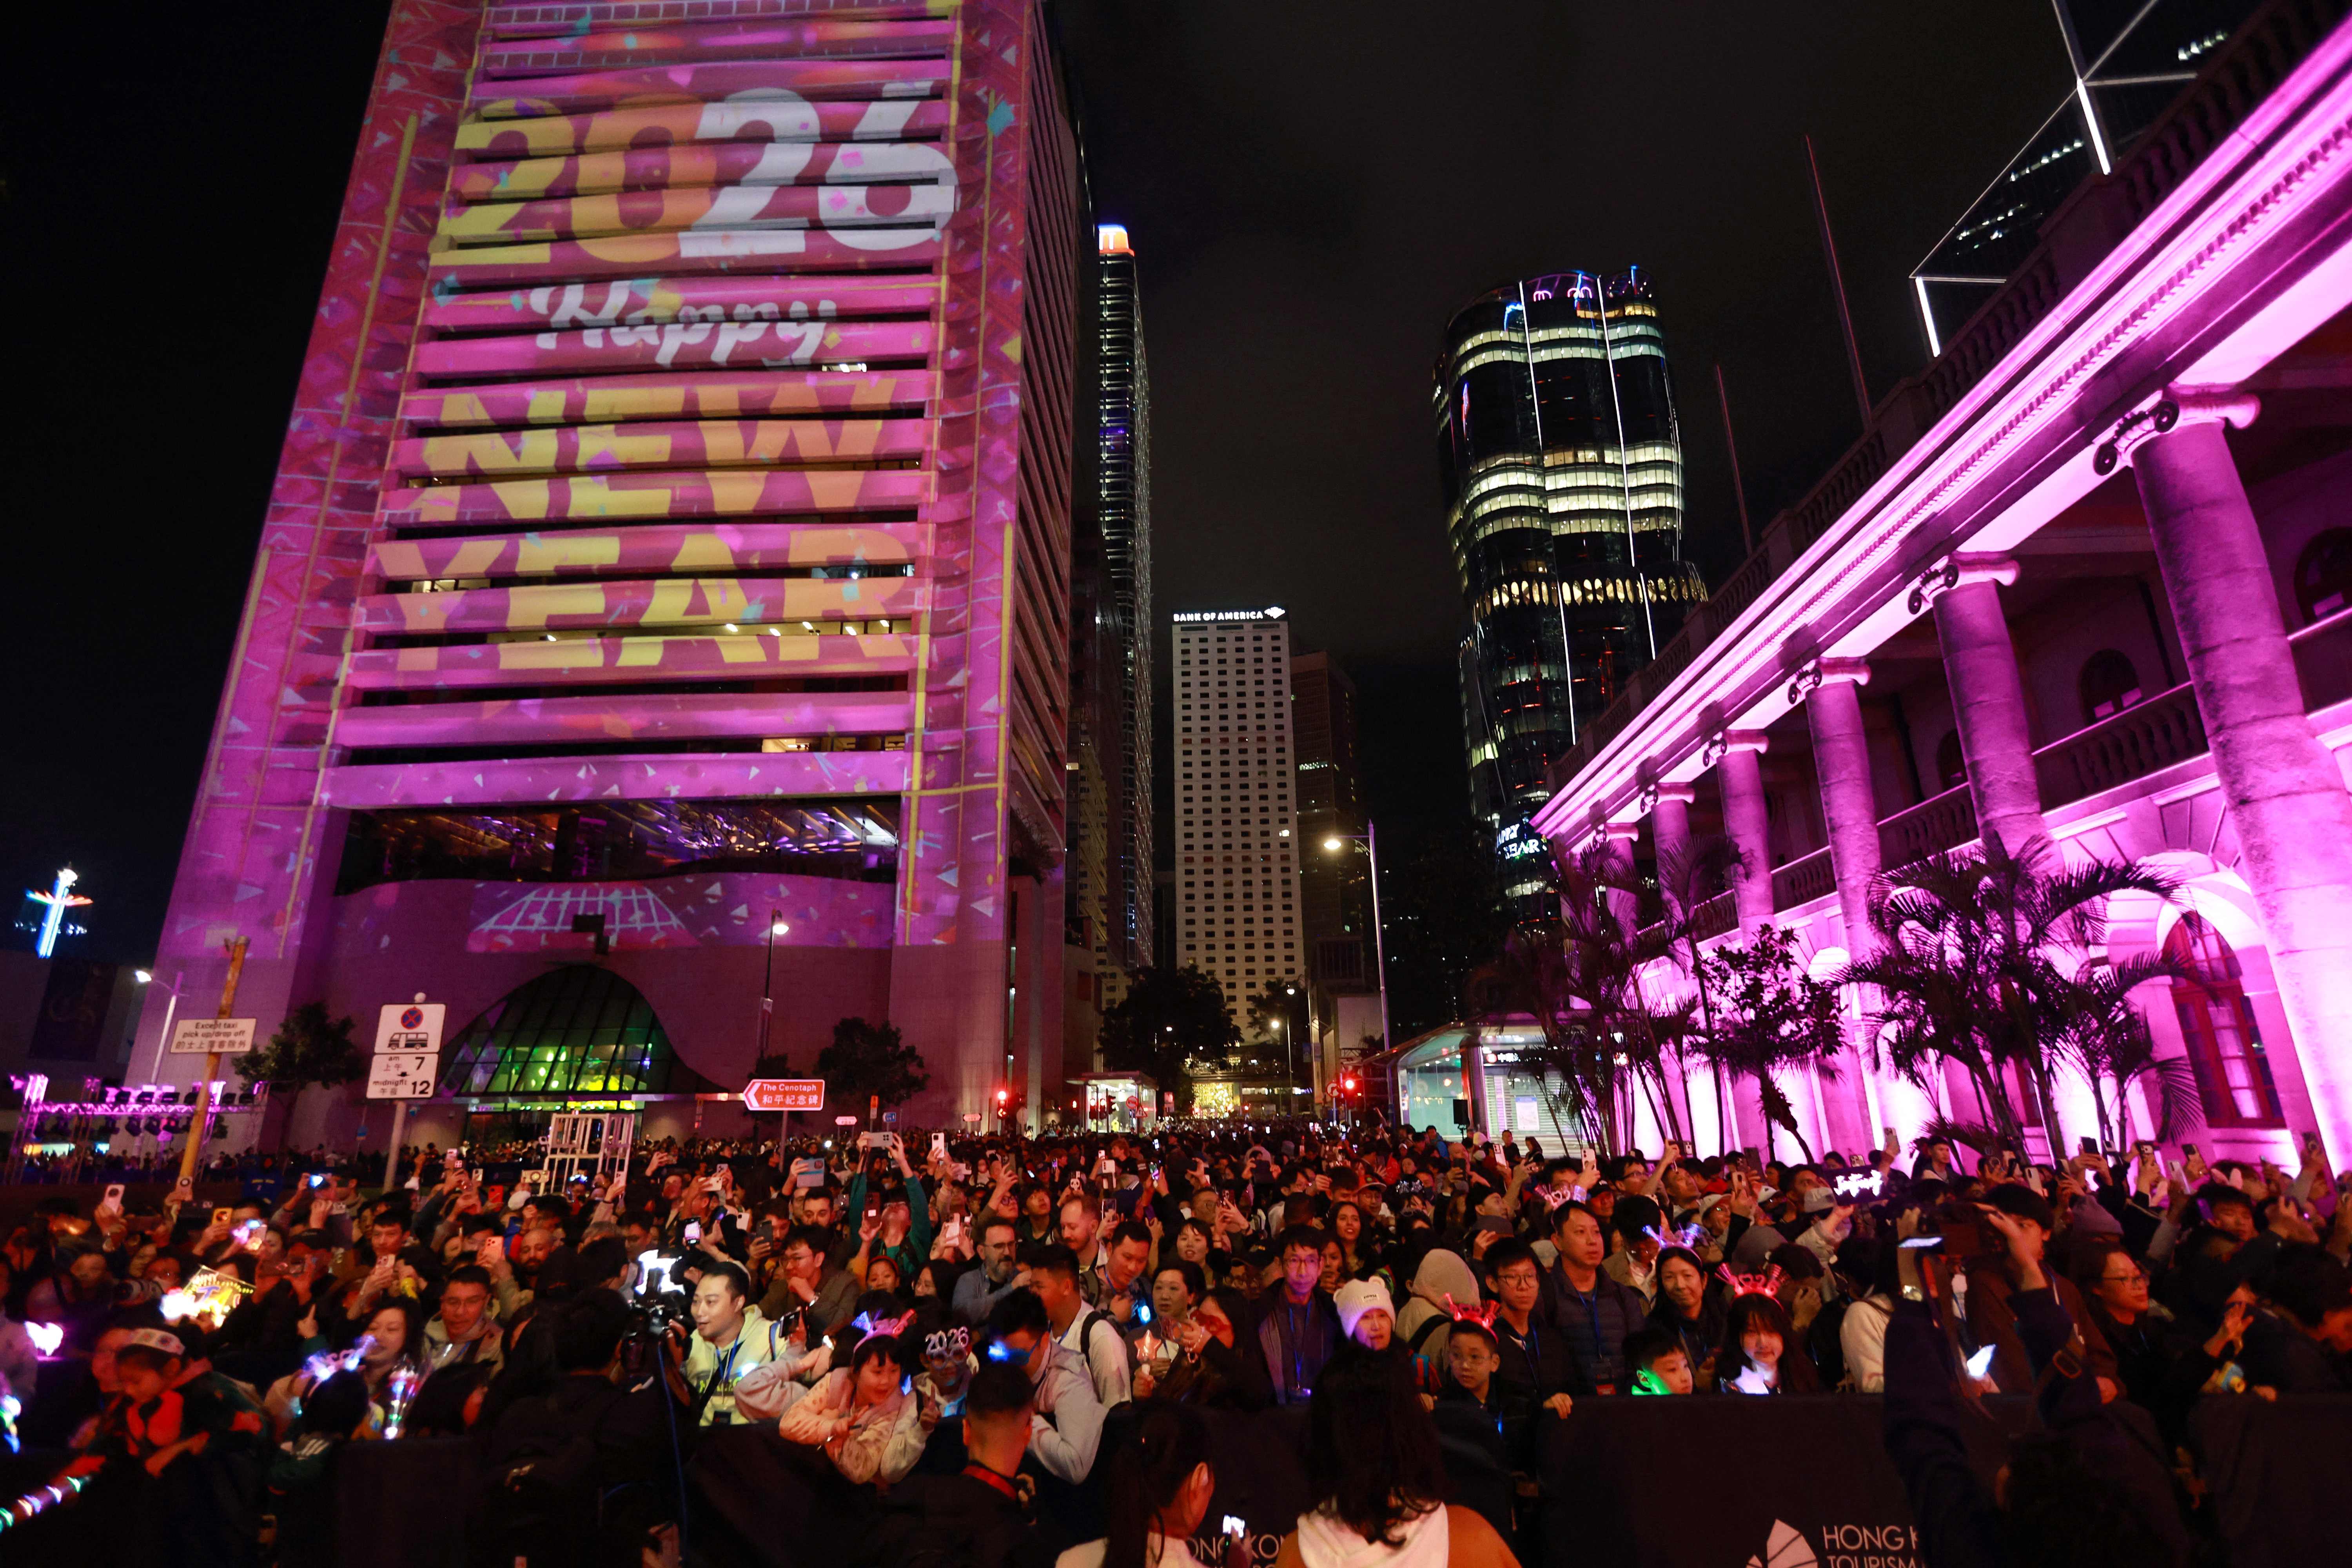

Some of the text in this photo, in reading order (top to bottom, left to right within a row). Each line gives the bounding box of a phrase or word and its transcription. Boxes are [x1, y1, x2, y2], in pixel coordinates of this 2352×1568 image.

[430, 80, 958, 263] 2026
[530, 280, 836, 368] Happy
[408, 378, 897, 521] NEW
[374, 529, 909, 670] YEAR
[1174, 611, 1263, 622] BANK OF AMERICA
[415, 1057, 425, 1071] 7
[412, 1081, 430, 1095] 12
[779, 1083, 817, 1092] Cenotaph
[762, 1094, 818, 1105] 和平紀念碑
[925, 1326, 969, 1355] 2026
[1823, 1524, 1904, 1551] HONG
[1827, 1555, 1916, 1568] TOURISM
